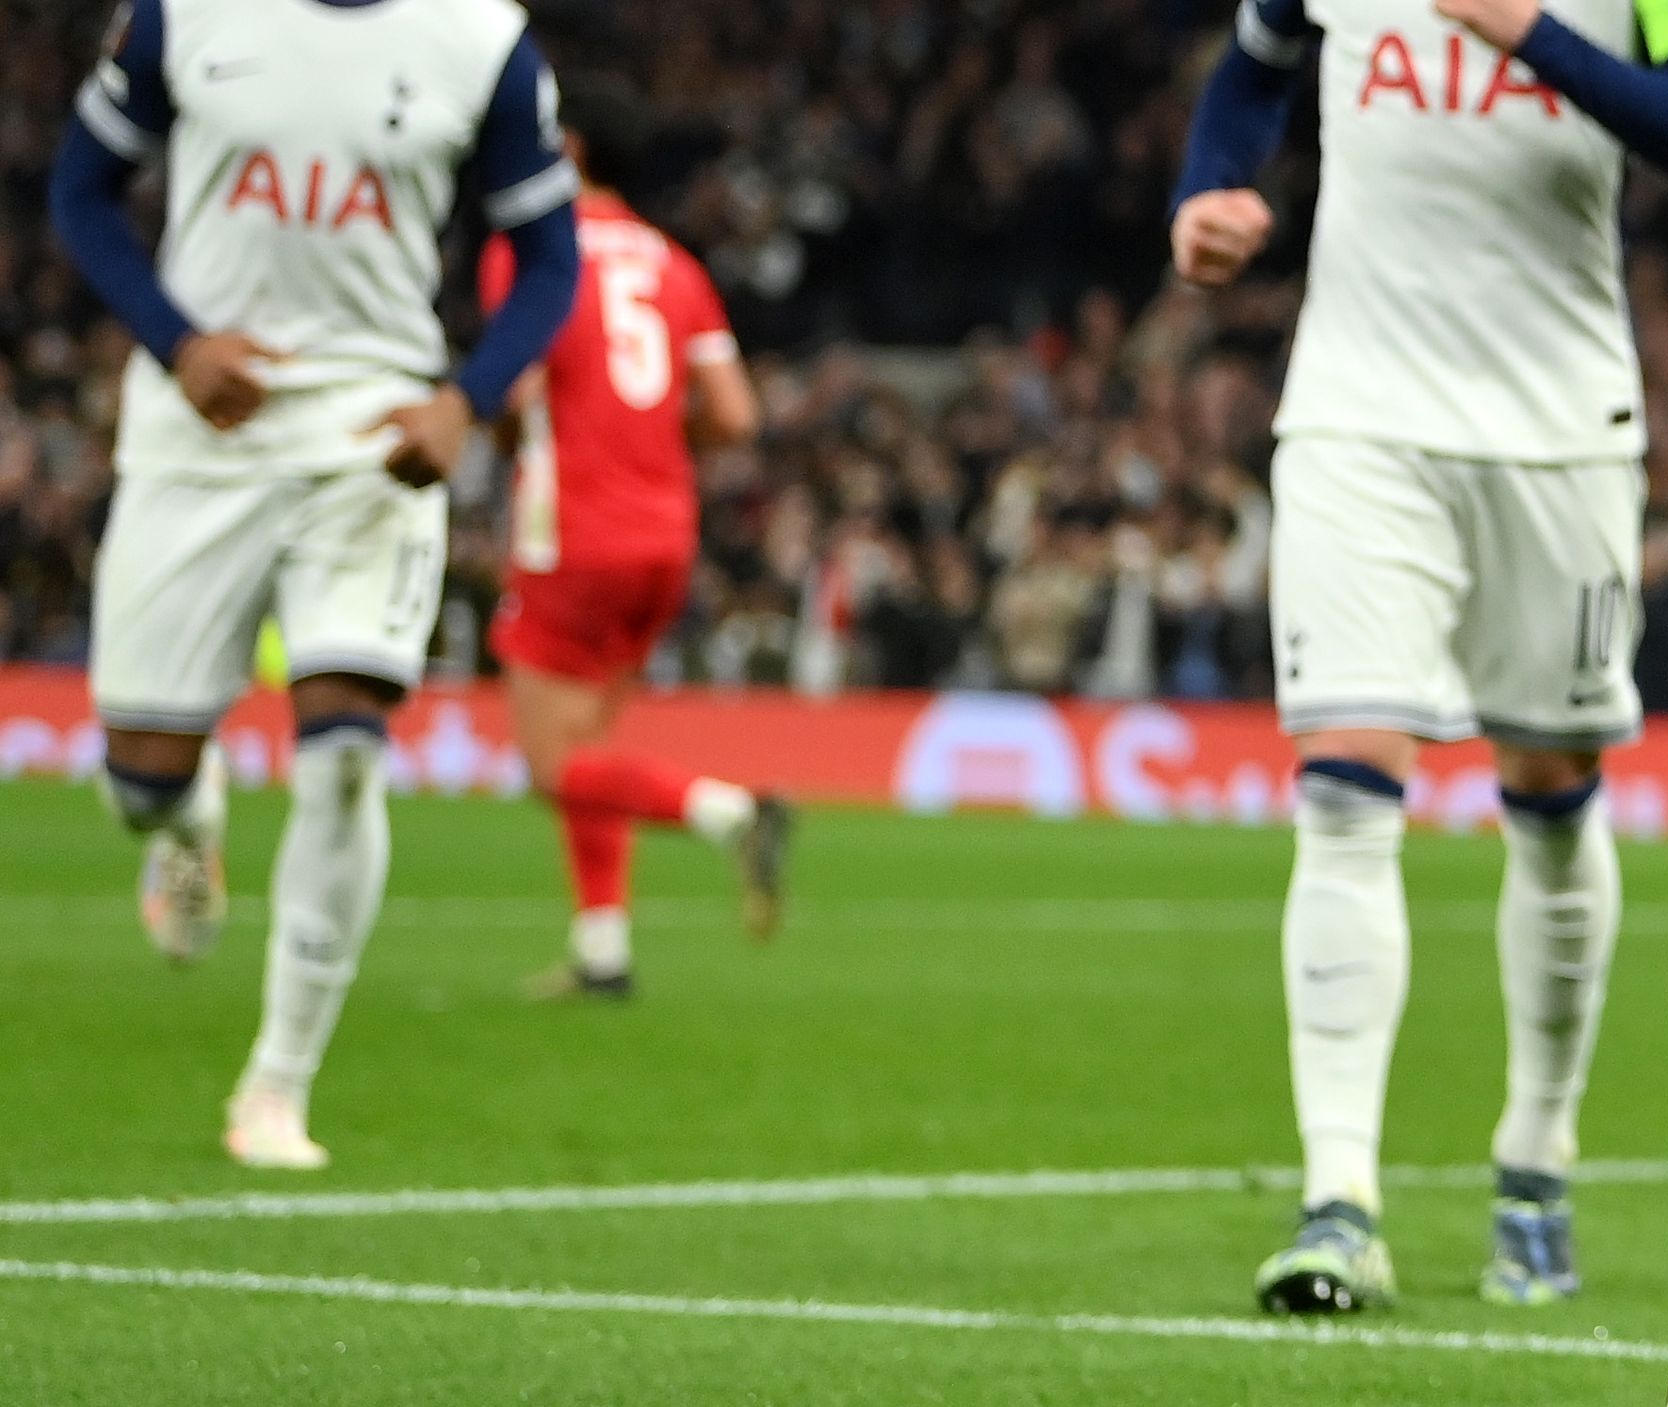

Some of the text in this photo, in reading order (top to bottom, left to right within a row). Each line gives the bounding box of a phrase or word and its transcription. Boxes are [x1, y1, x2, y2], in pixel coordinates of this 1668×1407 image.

[1358, 32, 1563, 119] AIA
[226, 149, 396, 235] AIA
[598, 264, 672, 410] 5
